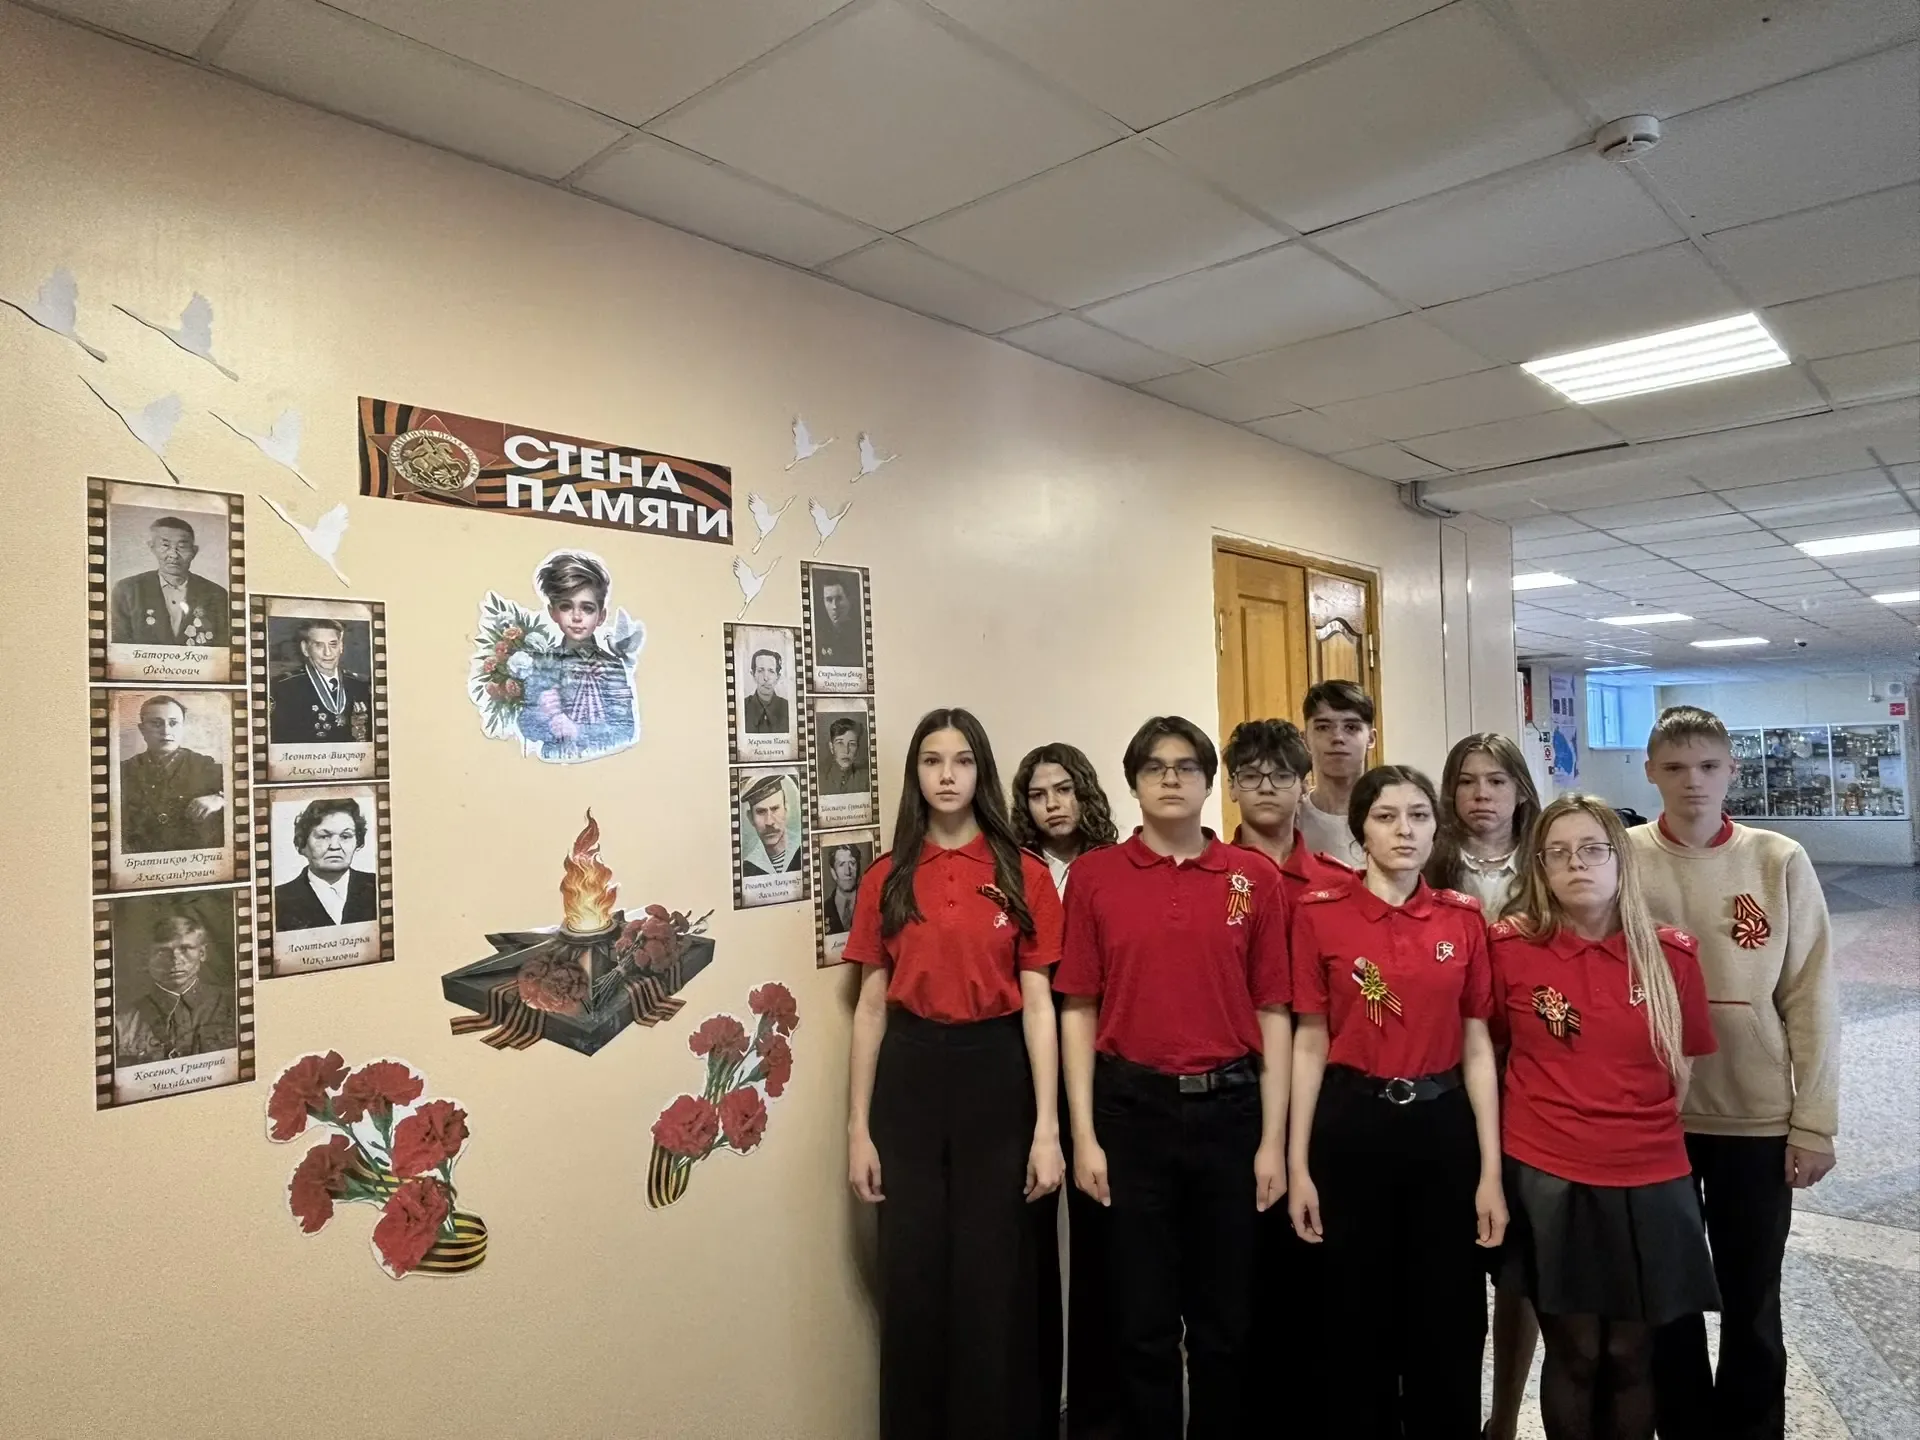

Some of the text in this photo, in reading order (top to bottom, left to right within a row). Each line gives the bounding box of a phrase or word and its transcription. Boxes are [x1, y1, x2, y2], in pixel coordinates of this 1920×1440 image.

[503, 434, 683, 495] СТЕНА
[506, 474, 729, 538] ПАМЯТИ
[132, 650, 209, 662] Баторов Яков
[143, 664, 200, 676] Федосович
[280, 751, 366, 762] Леонтьев Виктор
[288, 764, 359, 776] Александрович
[124, 851, 223, 869] Братников Юрий
[132, 868, 215, 884] Александрович
[285, 936, 371, 955] Леонтьева Дарья
[301, 951, 360, 965] Максимовна
[180, 1056, 226, 1074] Григорий
[149, 1074, 213, 1092] Михайлович
